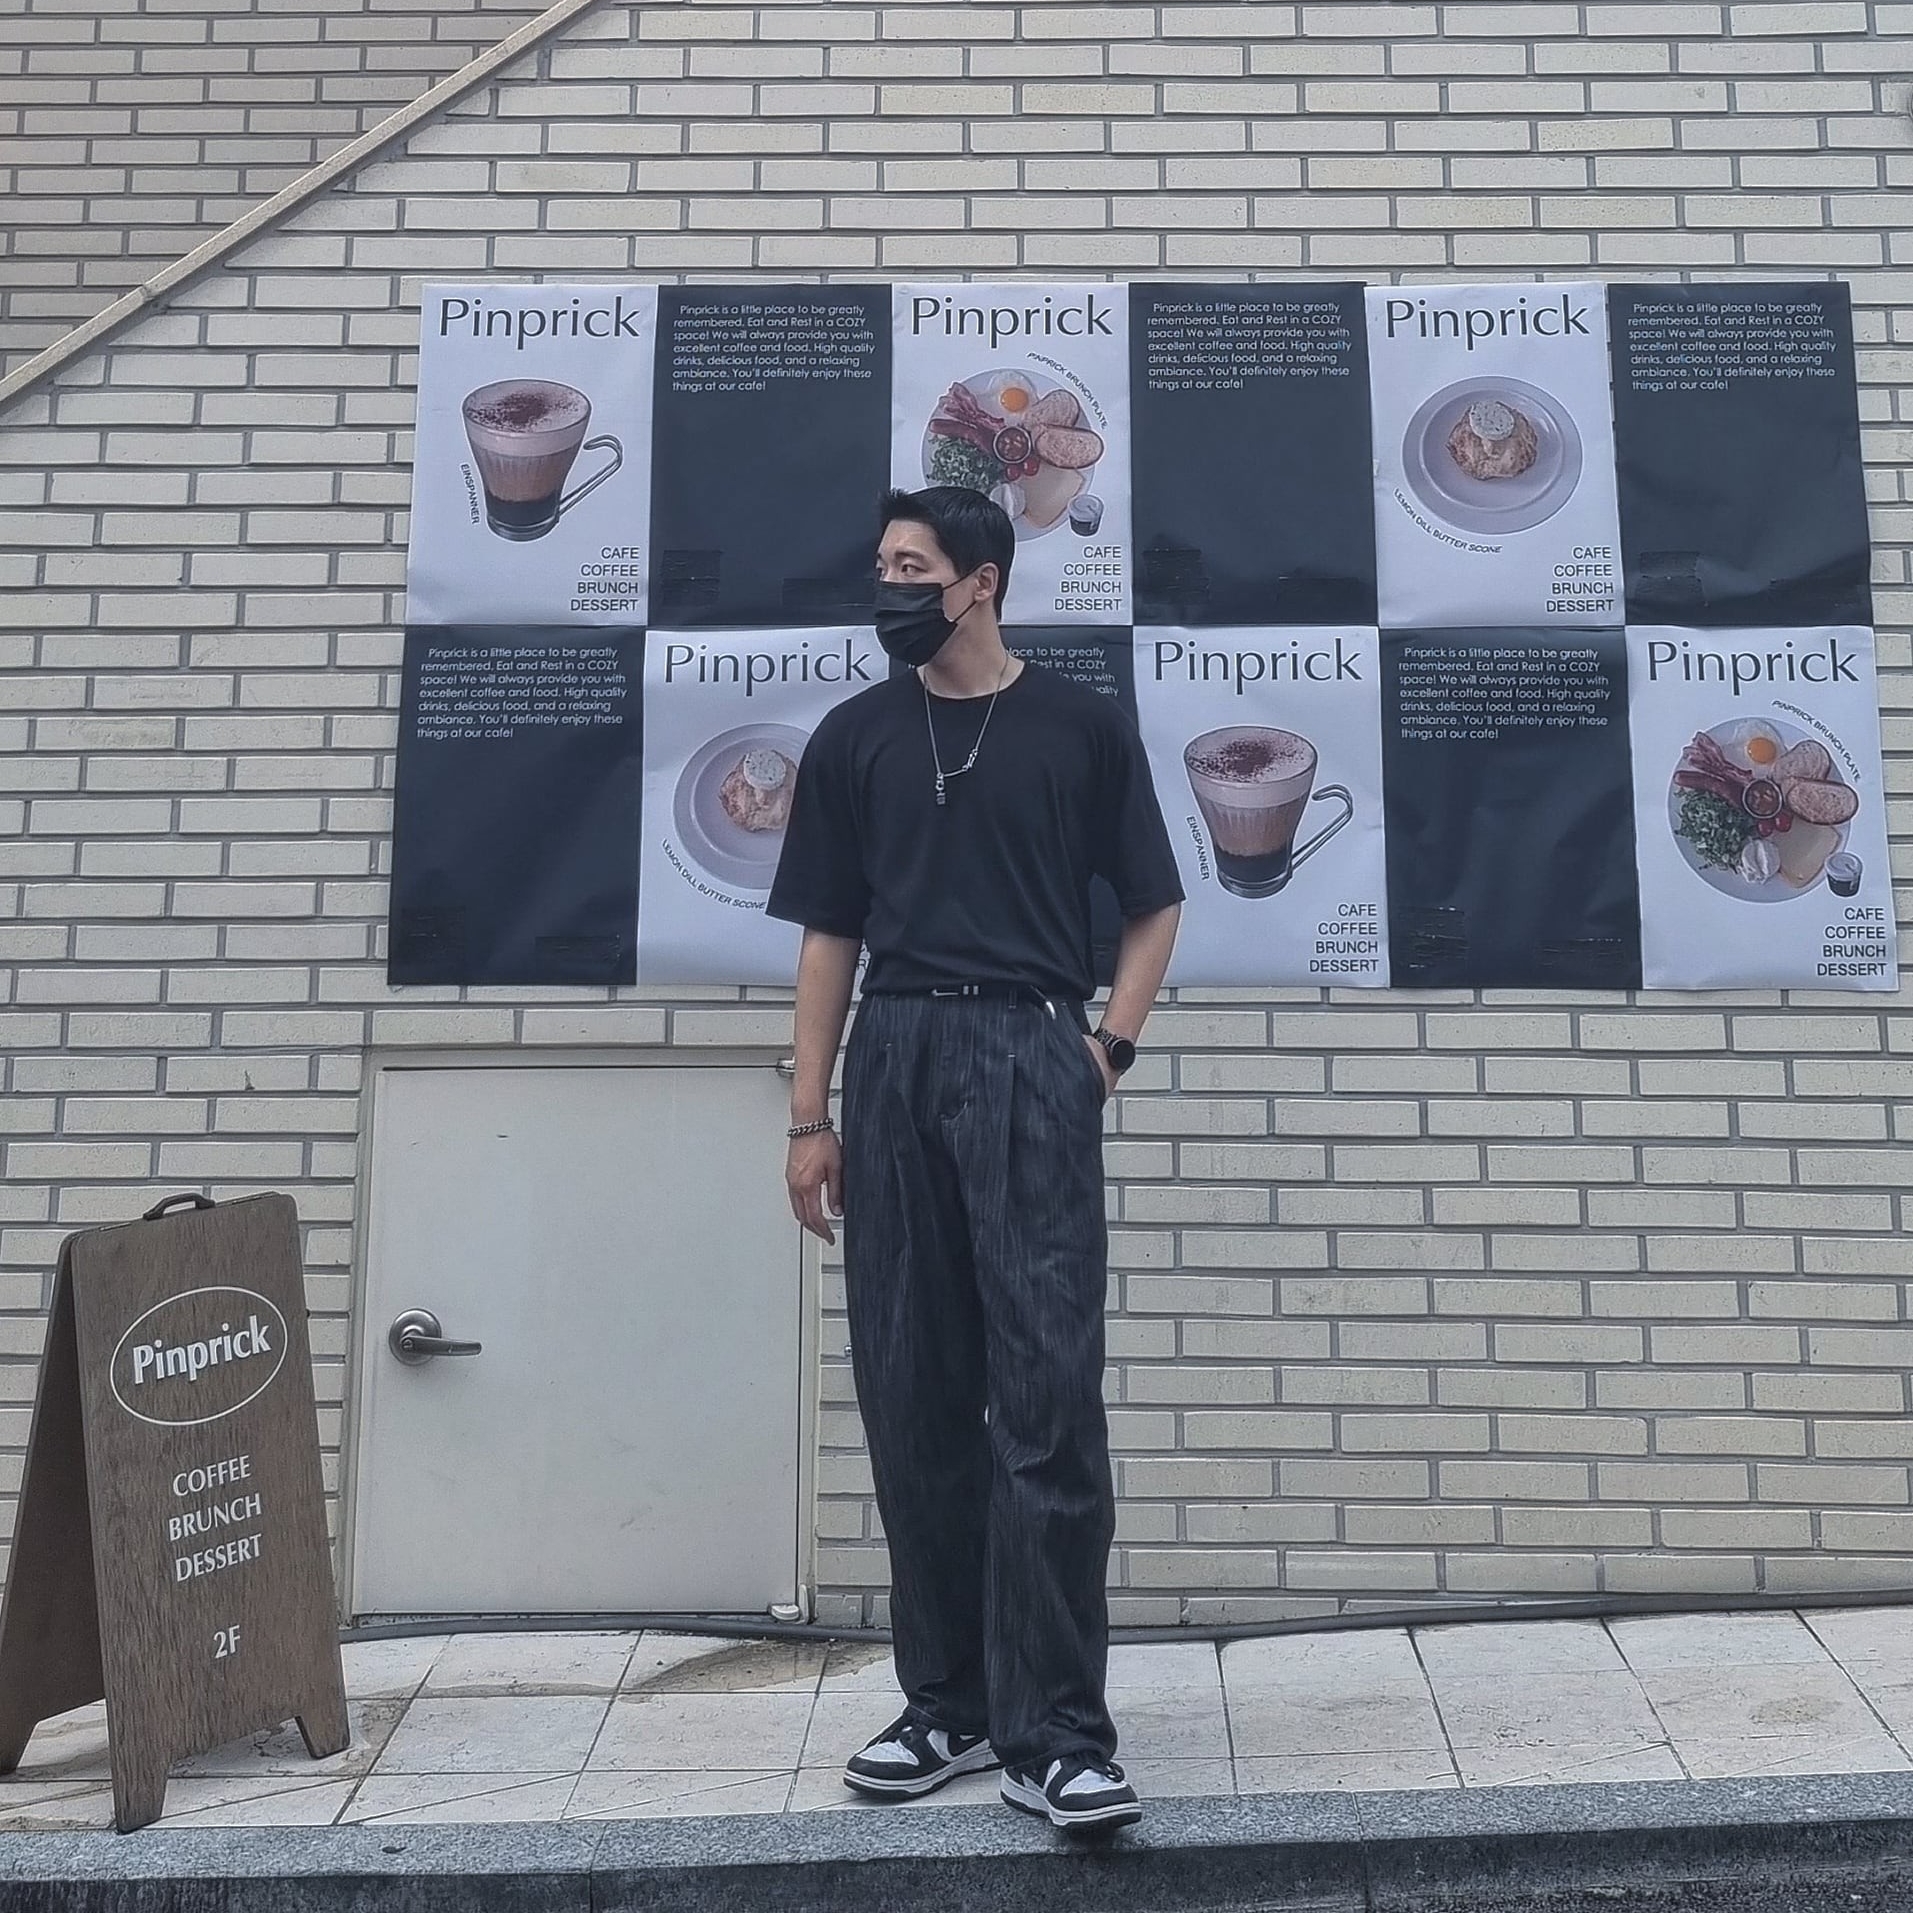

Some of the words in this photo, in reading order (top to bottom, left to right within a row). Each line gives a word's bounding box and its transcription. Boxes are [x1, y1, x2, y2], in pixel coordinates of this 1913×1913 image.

[440, 295, 640, 351] Pinprick
[912, 294, 1113, 349] Pinprick
[1386, 293, 1590, 351] Pinprick
[712, 331, 729, 340] We
[731, 330, 747, 339] will
[749, 330, 785, 340] always
[787, 330, 828, 340] provide
[830, 332, 850, 340] you
[851, 331, 874, 339] with
[1186, 328, 1204, 337] We
[1206, 328, 1222, 337] will
[1224, 328, 1261, 339] always
[1263, 327, 1303, 338] provide
[1306, 330, 1326, 338] you
[1668, 329, 1686, 338] We
[1688, 329, 1705, 337] will
[1707, 329, 1744, 340] always
[1746, 328, 1787, 339] provide
[1789, 330, 1809, 339] you
[1811, 328, 1834, 337] with
[673, 344, 720, 353] excellent
[722, 343, 757, 352] coffee
[759, 343, 781, 352] and
[814, 343, 838, 354] High
[839, 343, 875, 354] quality
[1148, 342, 1195, 351] excellent
[1198, 341, 1233, 350] coffee
[1235, 340, 1257, 350] and
[1290, 341, 1314, 352] High
[1316, 341, 1351, 351] quality
[1630, 342, 1678, 351] excellent
[1681, 341, 1716, 351] coffee
[1719, 342, 1741, 351] and
[1774, 341, 1798, 353] High
[1800, 341, 1836, 352] quality
[732, 368, 760, 378] You'll
[762, 368, 810, 379] definitely
[812, 368, 841, 380] enjoy
[843, 368, 872, 378] these
[1209, 366, 1237, 376] You'll
[1239, 366, 1288, 377] definitely
[1289, 368, 1319, 377] enjoy
[1321, 367, 1350, 375] these
[1693, 367, 1722, 377] You'll
[1724, 367, 1772, 378] definitely
[1774, 367, 1804, 378] enjoy
[1806, 367, 1835, 376] these
[1065, 371, 1094, 403] BRUNCH
[1091, 400, 1109, 430] PLATE
[460, 463, 481, 525] EINSPANNER
[1394, 488, 1416, 519] LEMON
[1432, 529, 1468, 550] BUTTER
[1467, 543, 1504, 554] SCONE
[601, 547, 640, 560] CAFE
[1083, 546, 1122, 559] CAFE
[1573, 546, 1612, 560] CAFE
[580, 564, 639, 577] COFFEE
[1063, 563, 1122, 576] COFFEE
[1554, 564, 1613, 578] COFFEE
[577, 581, 639, 594] BRUNCH
[1060, 580, 1122, 594] BRUNCH
[1551, 581, 1614, 595] BRUNCH
[570, 598, 639, 612] DESSERT
[1054, 598, 1123, 611] DESSERT
[1546, 598, 1615, 613] DESSERT
[1036, 647, 1048, 657] to
[1050, 646, 1065, 657] be
[1067, 647, 1105, 659] greatly
[664, 638, 872, 697] Pinprick
[1054, 659, 1065, 669] in
[1066, 661, 1075, 669] a
[1076, 659, 1106, 670] COZY
[1154, 637, 1362, 696] Pinprick
[1647, 638, 1860, 696] Pinprick
[460, 675, 477, 684] We
[479, 674, 496, 683] will
[498, 674, 534, 685] always
[537, 674, 578, 685] provide
[581, 676, 601, 684] you
[603, 675, 626, 683] with
[1093, 672, 1116, 683] with
[1439, 675, 1458, 684] We
[1460, 674, 1477, 684] will
[1479, 675, 1517, 686] always
[1519, 675, 1560, 686] provide
[1563, 678, 1583, 686] you
[419, 688, 468, 698] excellent
[470, 687, 505, 697] coffee
[508, 688, 530, 697] and
[564, 688, 588, 699] High
[590, 687, 627, 698] quality
[1400, 688, 1449, 698] excellent
[1451, 688, 1488, 698] coffee
[1490, 689, 1513, 698] and
[1547, 689, 1571, 700] High
[1574, 689, 1610, 700] quality
[479, 714, 508, 724] You'll
[510, 714, 559, 726] definitely
[561, 714, 591, 726] enjoy
[594, 714, 623, 724] these
[1463, 715, 1492, 725] You'll
[1494, 715, 1544, 726] definitely
[1546, 716, 1576, 727] enjoy
[1578, 716, 1608, 725] these
[1813, 721, 1846, 754] BRUNCH
[1843, 752, 1862, 783] PLATE
[1186, 815, 1210, 881] EINSPANNER
[662, 838, 683, 873] LEMON
[697, 883, 733, 905] BUTTER
[732, 898, 767, 910] SCONE
[1337, 903, 1377, 917] CAFE
[1844, 907, 1885, 921] CAFE
[1317, 922, 1378, 935] COFFEE
[1824, 925, 1887, 940] COFFEE
[1315, 940, 1378, 954] BRUNCH
[1822, 944, 1887, 958] BRUNCH
[1309, 958, 1380, 973] DESSERT
[1817, 962, 1888, 977] DESSERT
[132, 1315, 272, 1385] Pinprick
[172, 1455, 251, 1496] COFFEE
[168, 1493, 262, 1541] BRUNCH
[175, 1533, 262, 1582] DESSERT
[213, 1625, 241, 1659] 2F
